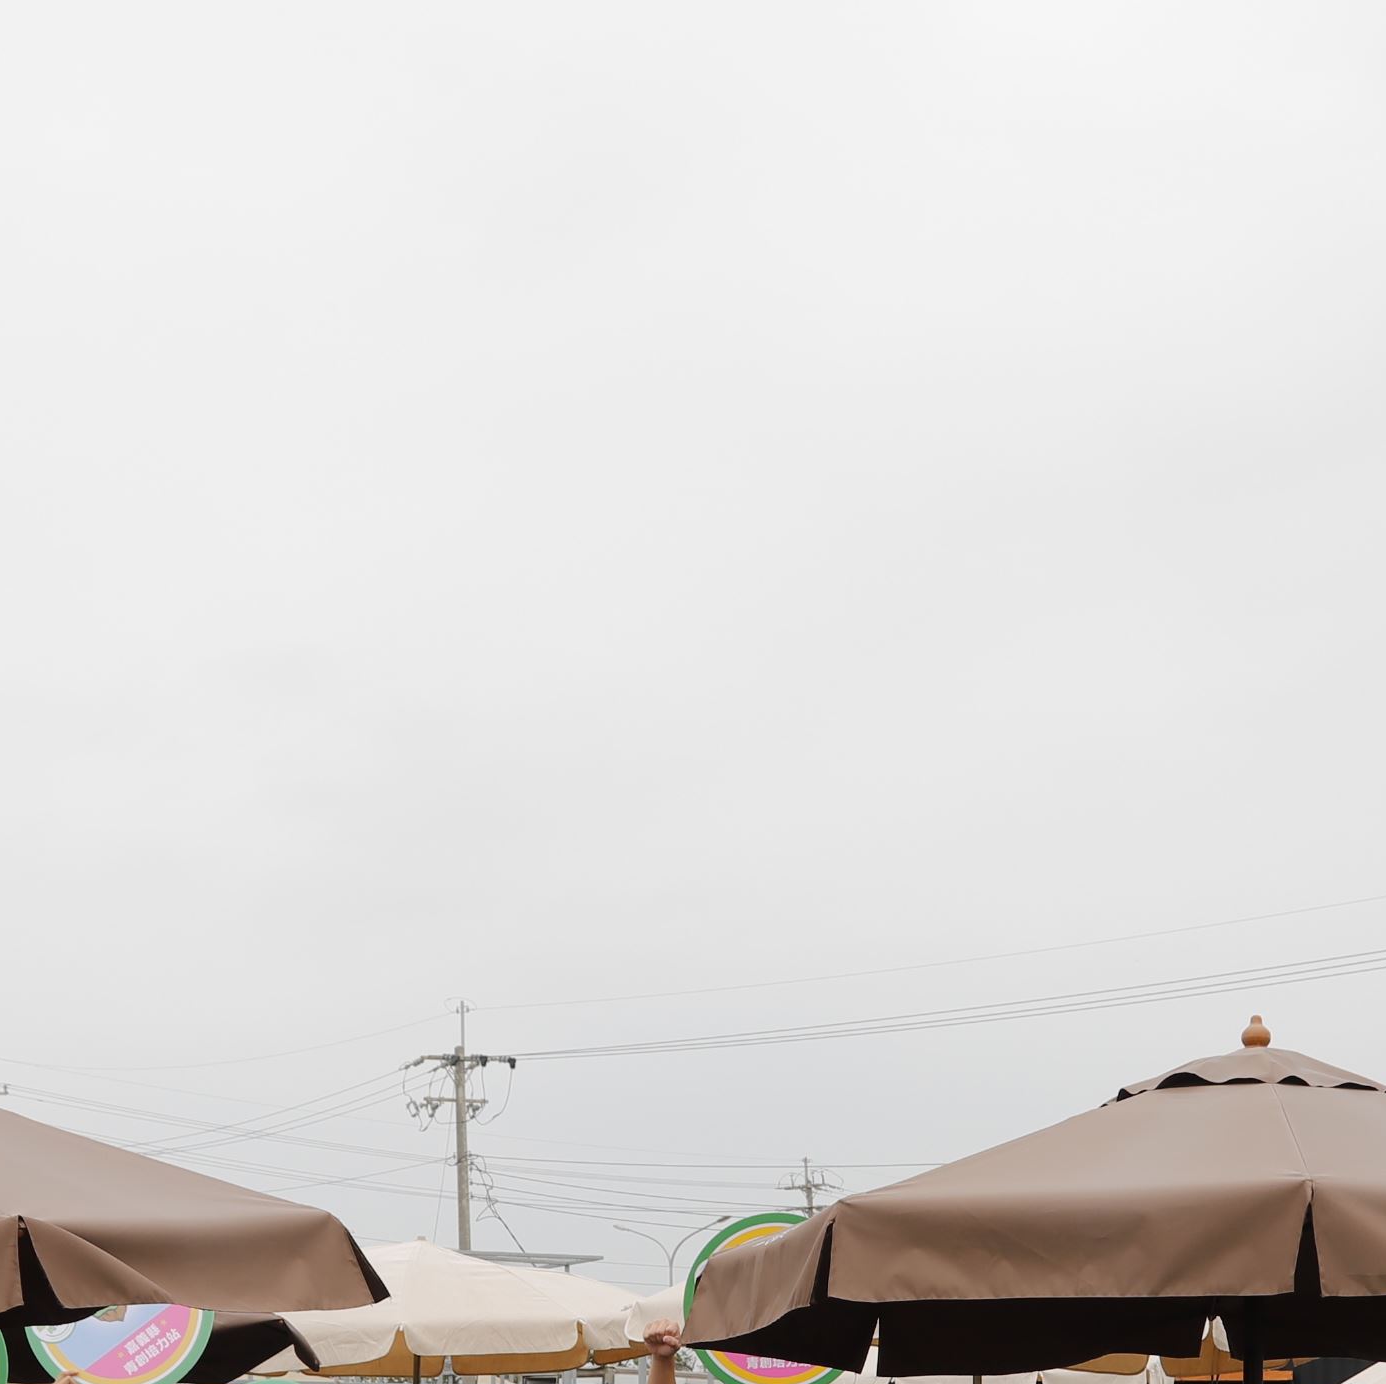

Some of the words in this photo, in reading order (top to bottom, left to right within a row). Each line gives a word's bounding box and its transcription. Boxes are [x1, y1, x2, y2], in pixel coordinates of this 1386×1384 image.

[123, 1327, 182, 1376] 青創培力站
[124, 1323, 161, 1355] 嘉義縣
